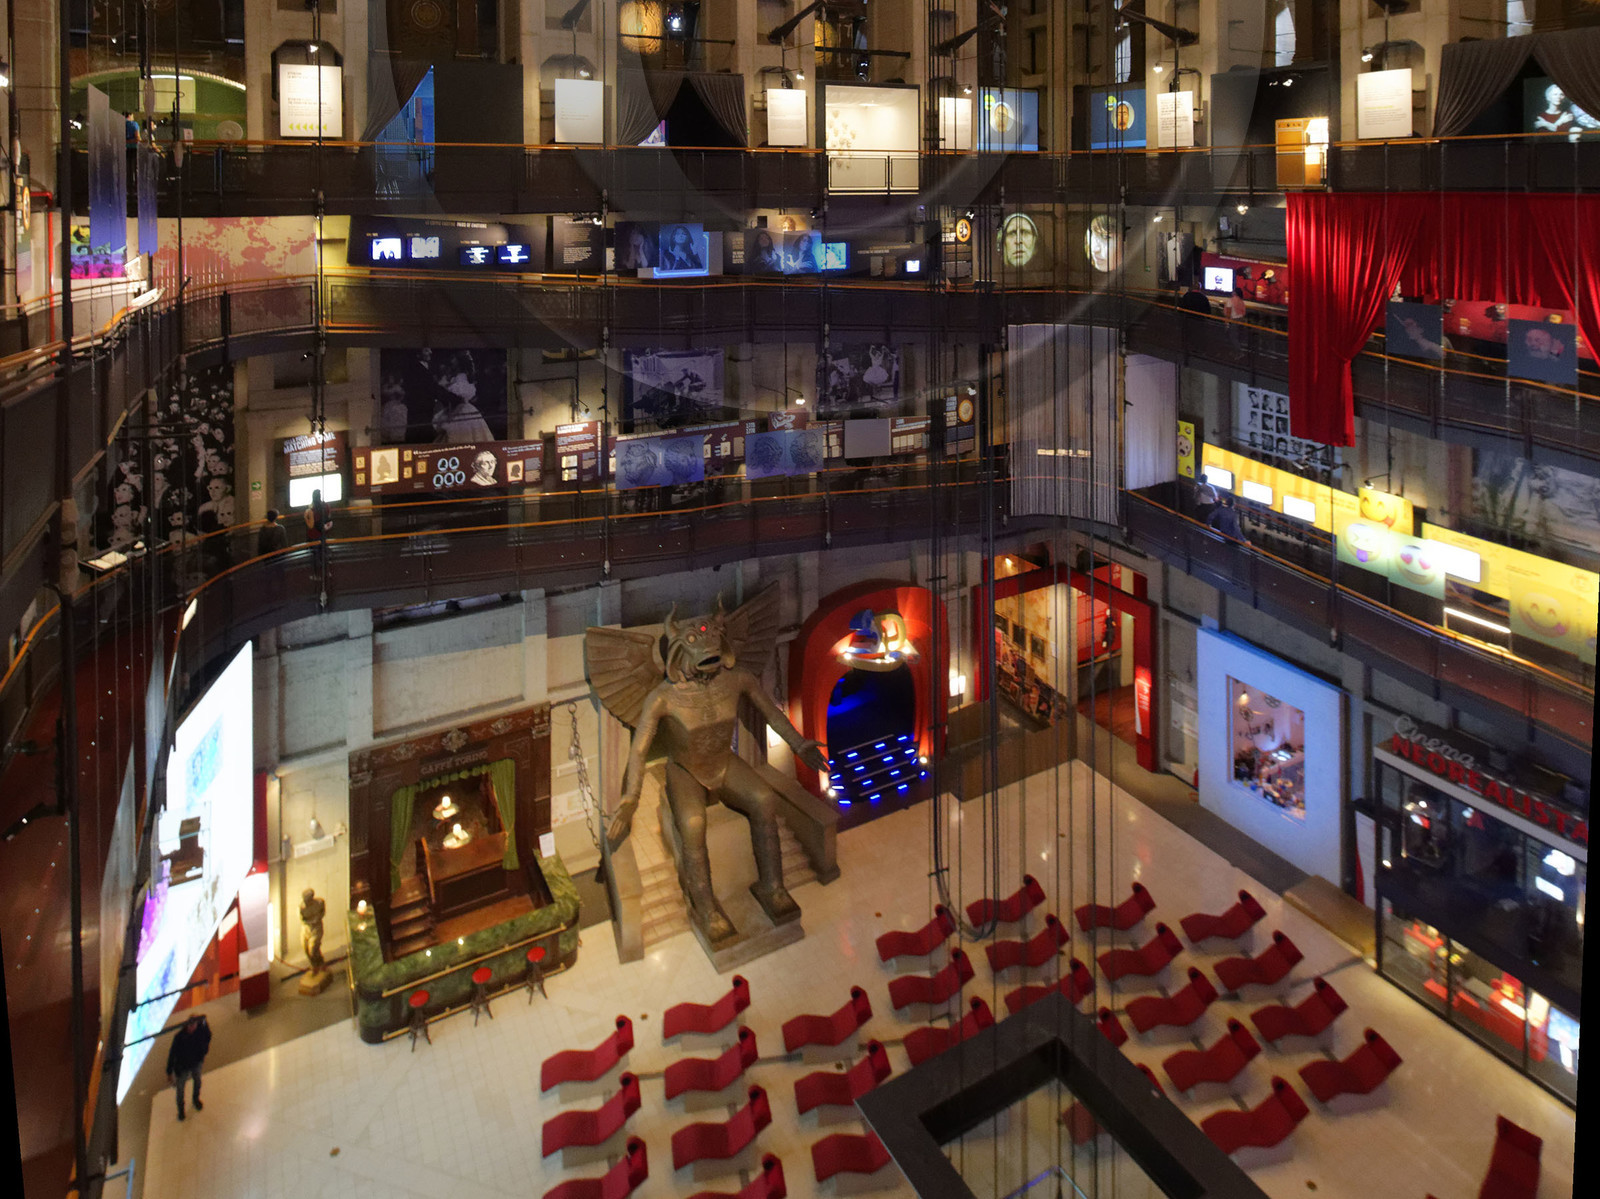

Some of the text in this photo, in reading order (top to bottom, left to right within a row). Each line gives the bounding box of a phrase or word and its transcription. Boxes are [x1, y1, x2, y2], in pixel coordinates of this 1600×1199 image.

[284, 436, 316, 454] MATCHING
[455, 750, 488, 766] TORINO
[1394, 714, 1475, 769] Cinema
[1391, 733, 1589, 844] NEOREALISTA
